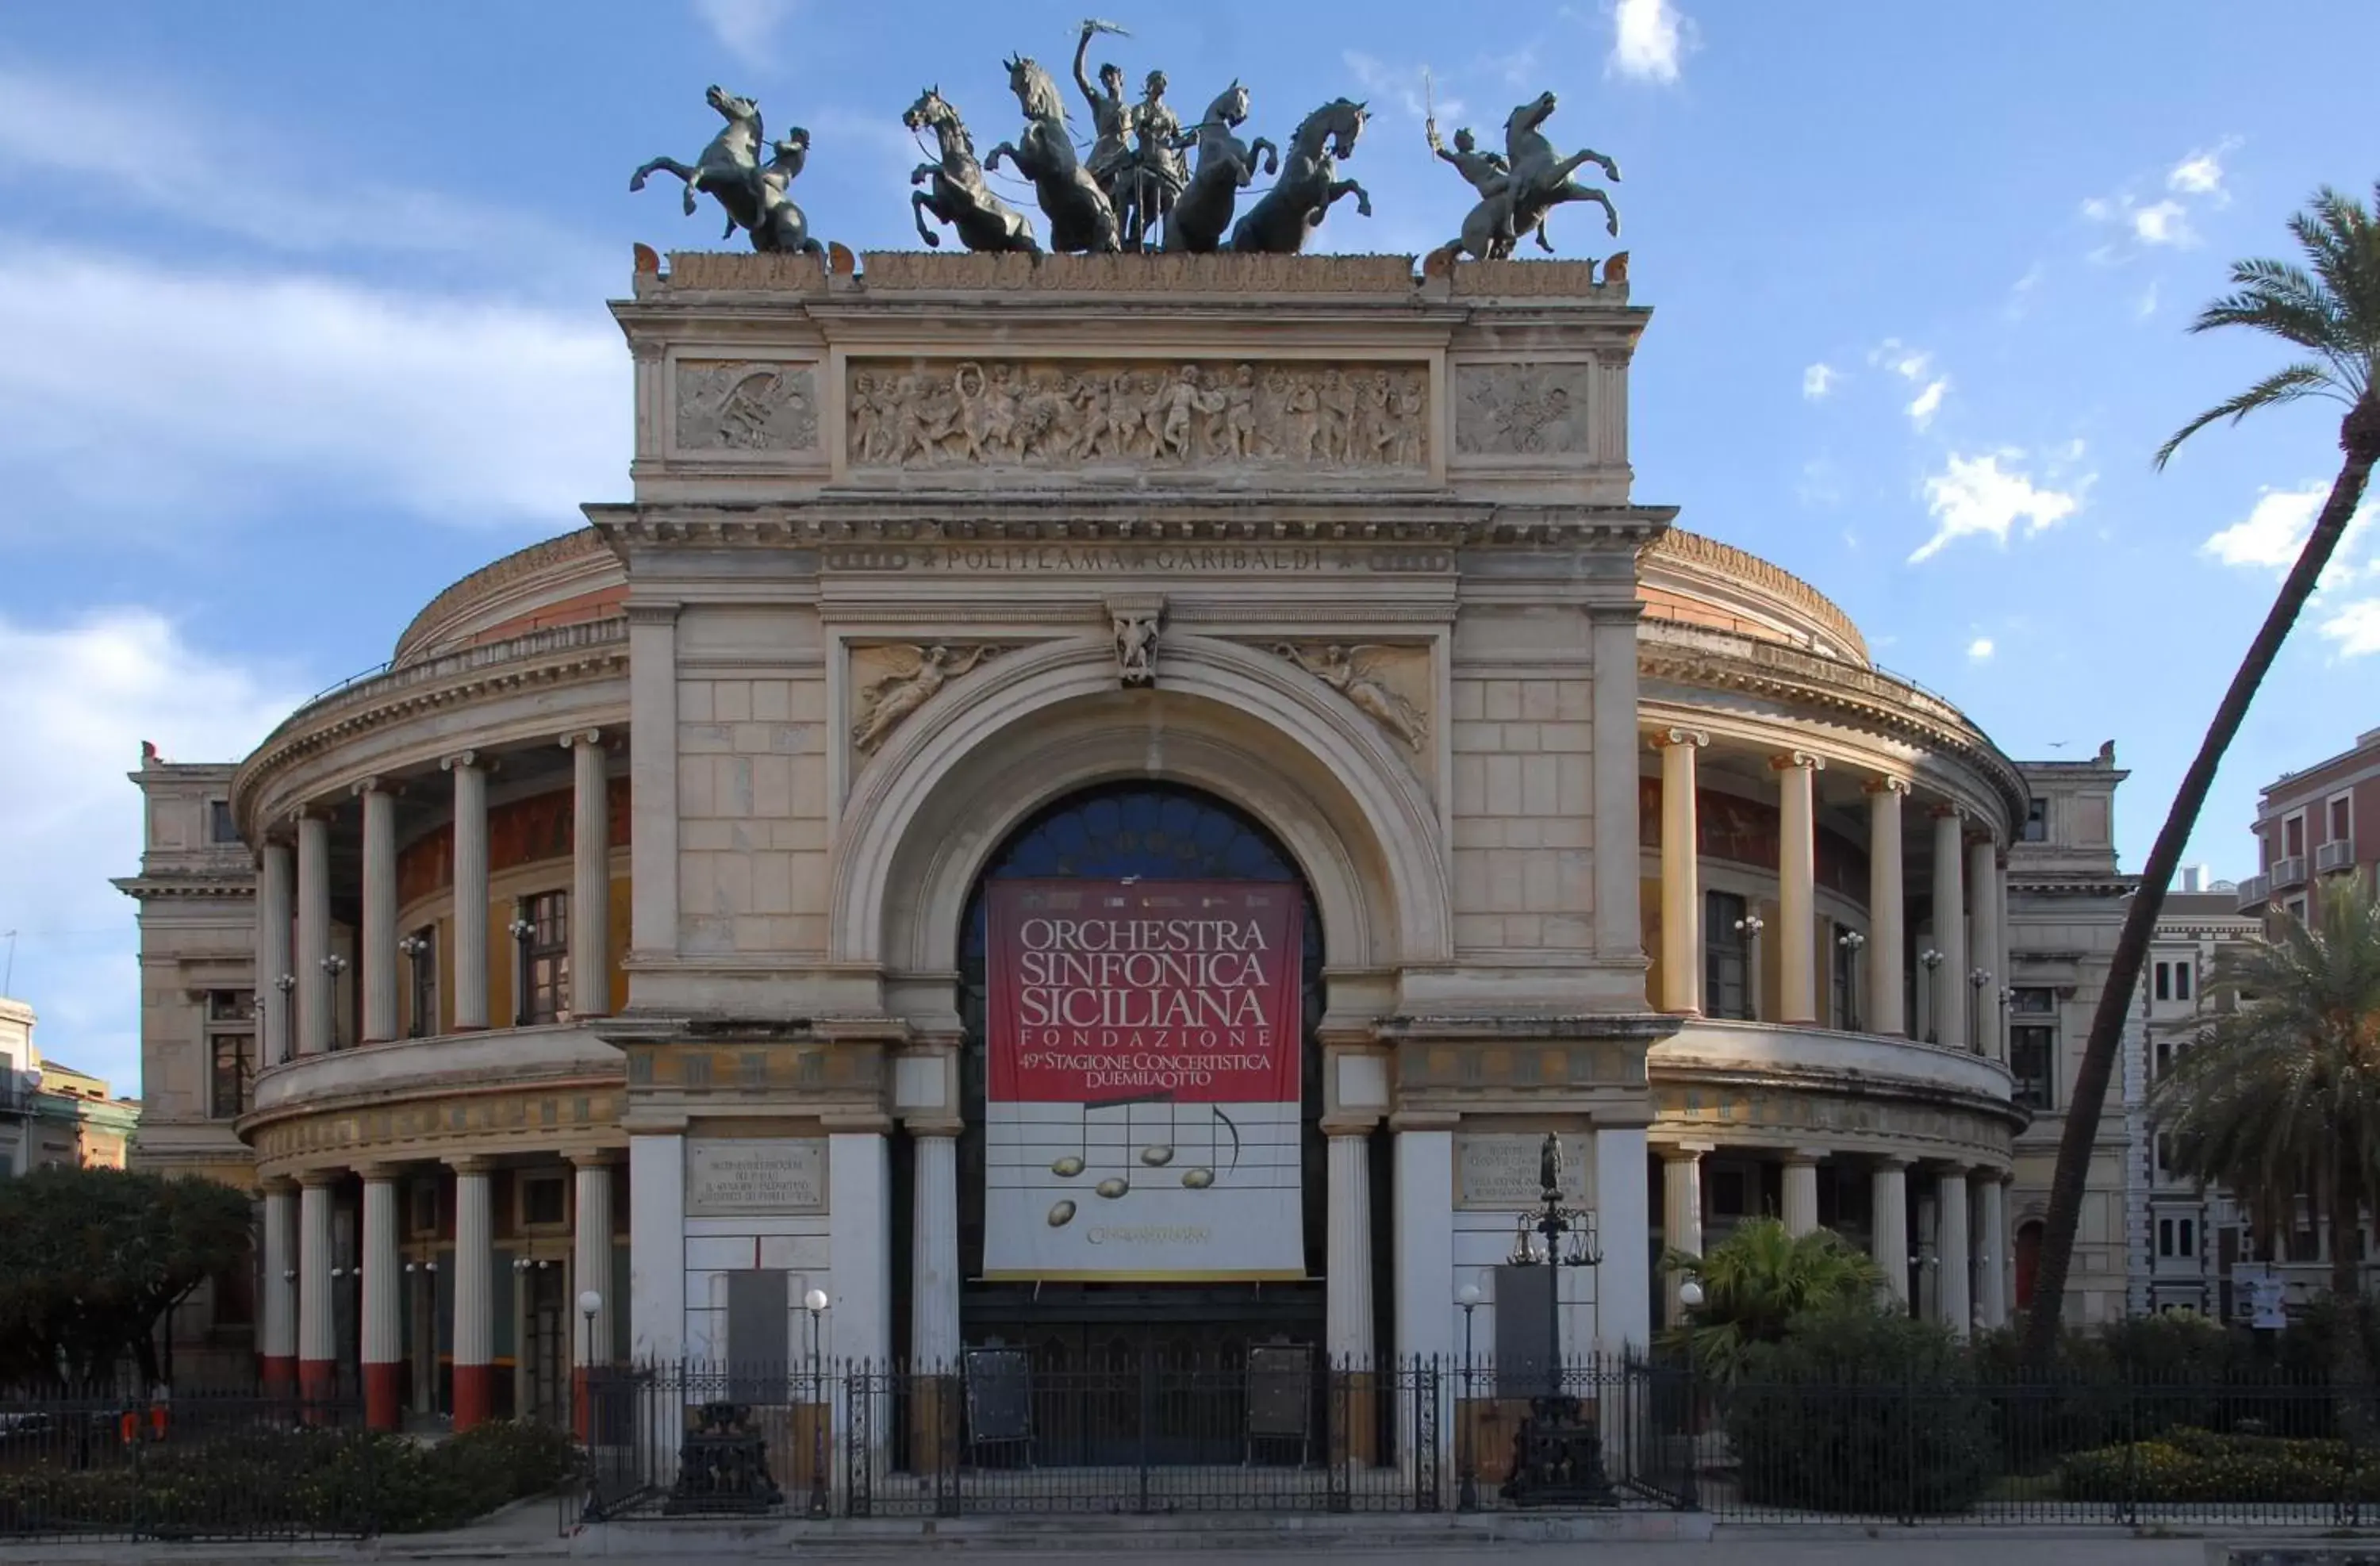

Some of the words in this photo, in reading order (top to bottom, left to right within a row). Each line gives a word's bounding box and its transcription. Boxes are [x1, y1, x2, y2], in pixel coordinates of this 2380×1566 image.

[946, 547, 1125, 570] POLITEAMA
[1156, 546, 1321, 570] GARIBALDI
[1020, 918, 1269, 951] ORCHESTRA
[1020, 952, 1269, 988] SINFONICA
[1020, 988, 1268, 1027] SICILIANA
[1020, 1030, 1270, 1047] FONDAZIONE
[1045, 1051, 1130, 1069] STAGIONE
[1133, 1052, 1270, 1070] CONCERTISTICA
[1086, 1071, 1211, 1088] DUEMILAOTTO
